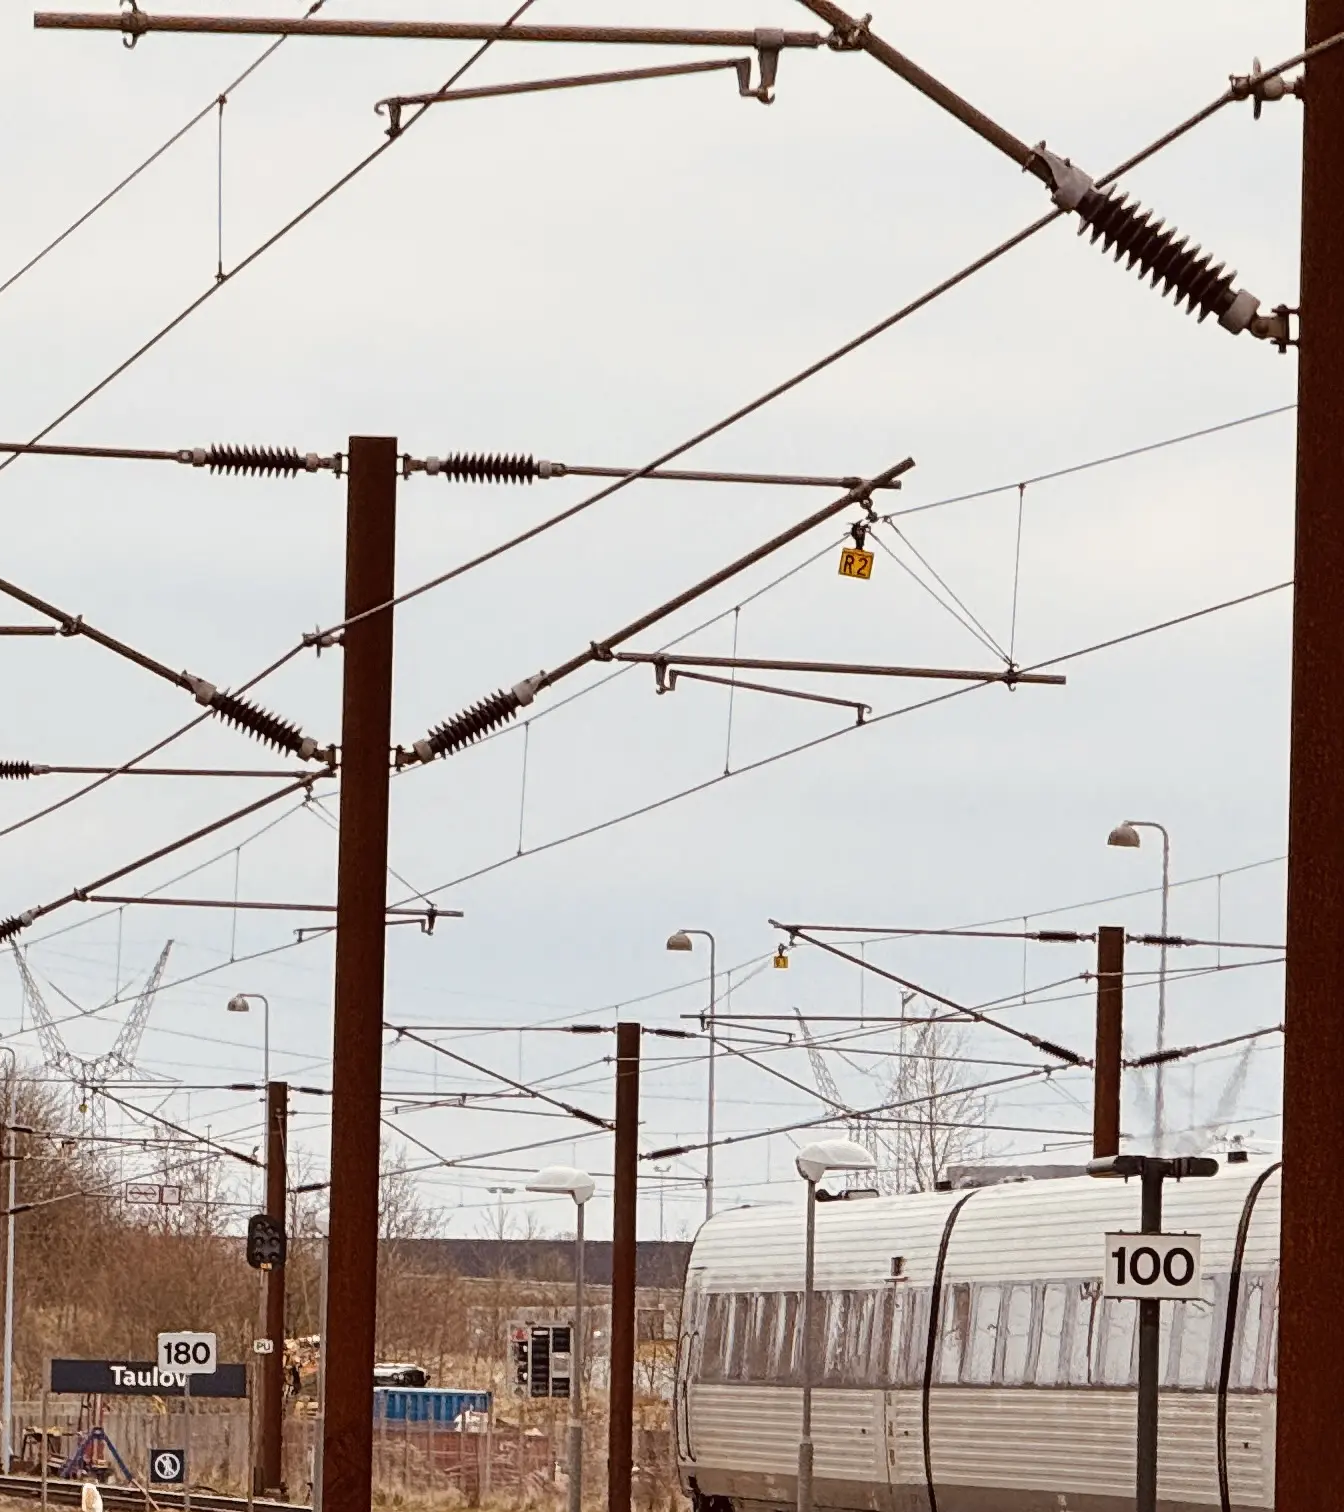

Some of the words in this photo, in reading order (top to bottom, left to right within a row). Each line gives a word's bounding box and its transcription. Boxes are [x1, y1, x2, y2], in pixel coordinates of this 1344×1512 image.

[843, 554, 869, 577] R2
[1112, 1246, 1195, 1287] 100
[163, 1341, 211, 1365] 180
[256, 1341, 271, 1351] PU
[109, 1365, 188, 1388] Taulov
